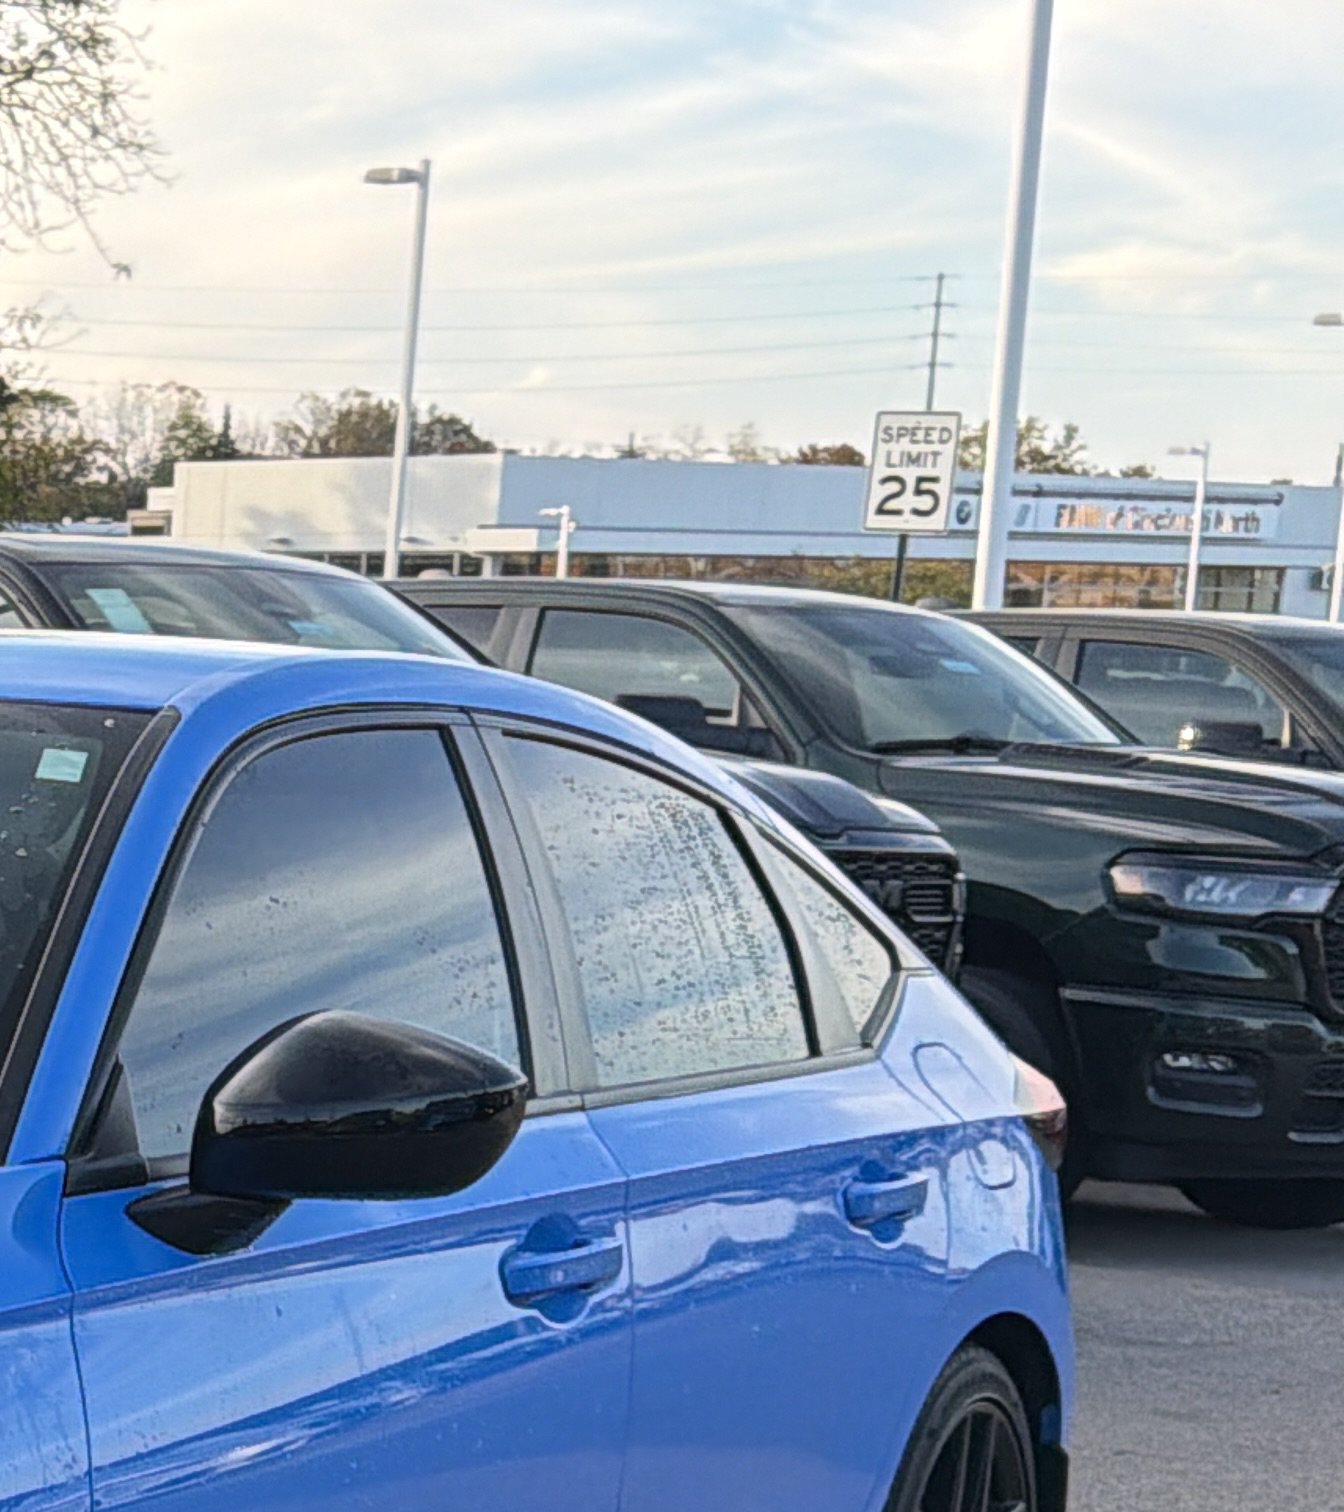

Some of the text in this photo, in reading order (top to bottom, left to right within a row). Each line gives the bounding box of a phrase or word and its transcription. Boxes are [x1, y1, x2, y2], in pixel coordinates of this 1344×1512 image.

[880, 425, 953, 445] SPEED
[885, 450, 943, 469] LIMIT
[874, 475, 941, 517] 25
